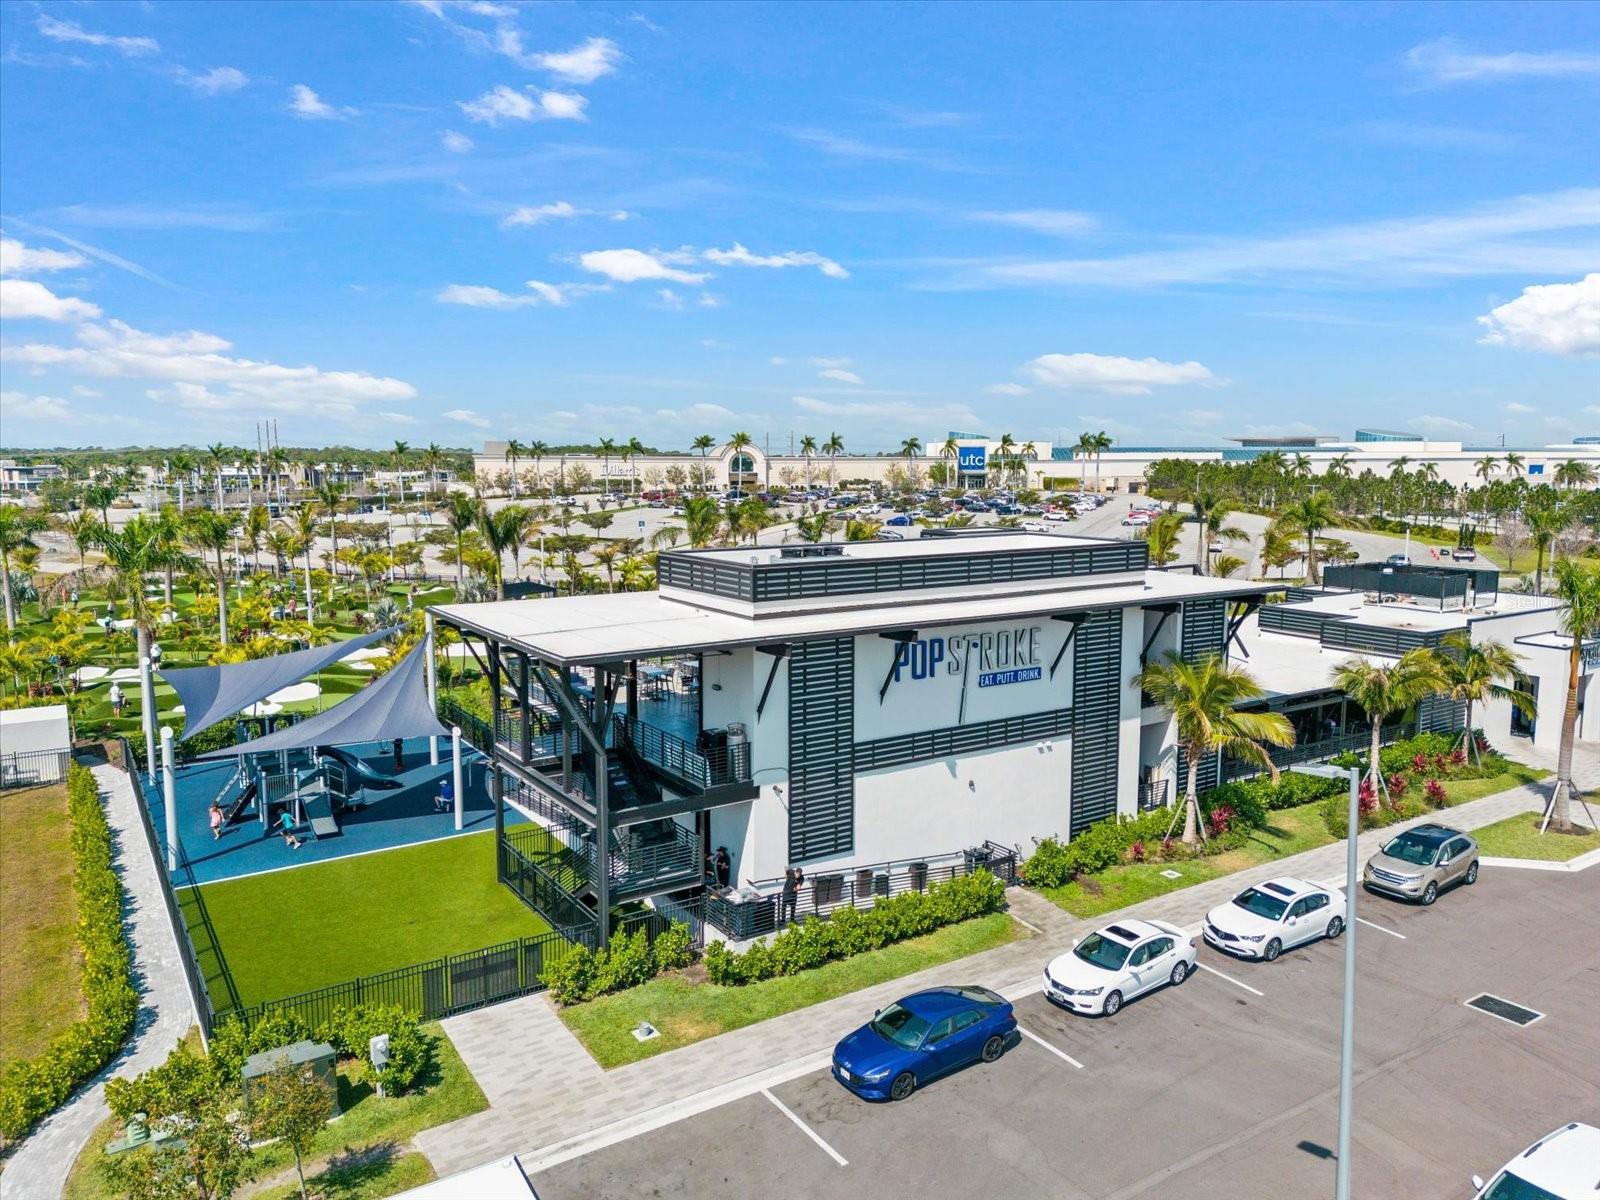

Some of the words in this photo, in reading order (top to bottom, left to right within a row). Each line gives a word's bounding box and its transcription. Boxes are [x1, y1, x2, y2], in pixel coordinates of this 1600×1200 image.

[960, 453, 984, 466] utc
[980, 674, 995, 687] EAT.
[996, 671, 1016, 685] PUTT.
[1017, 668, 1041, 682] DRINK.
